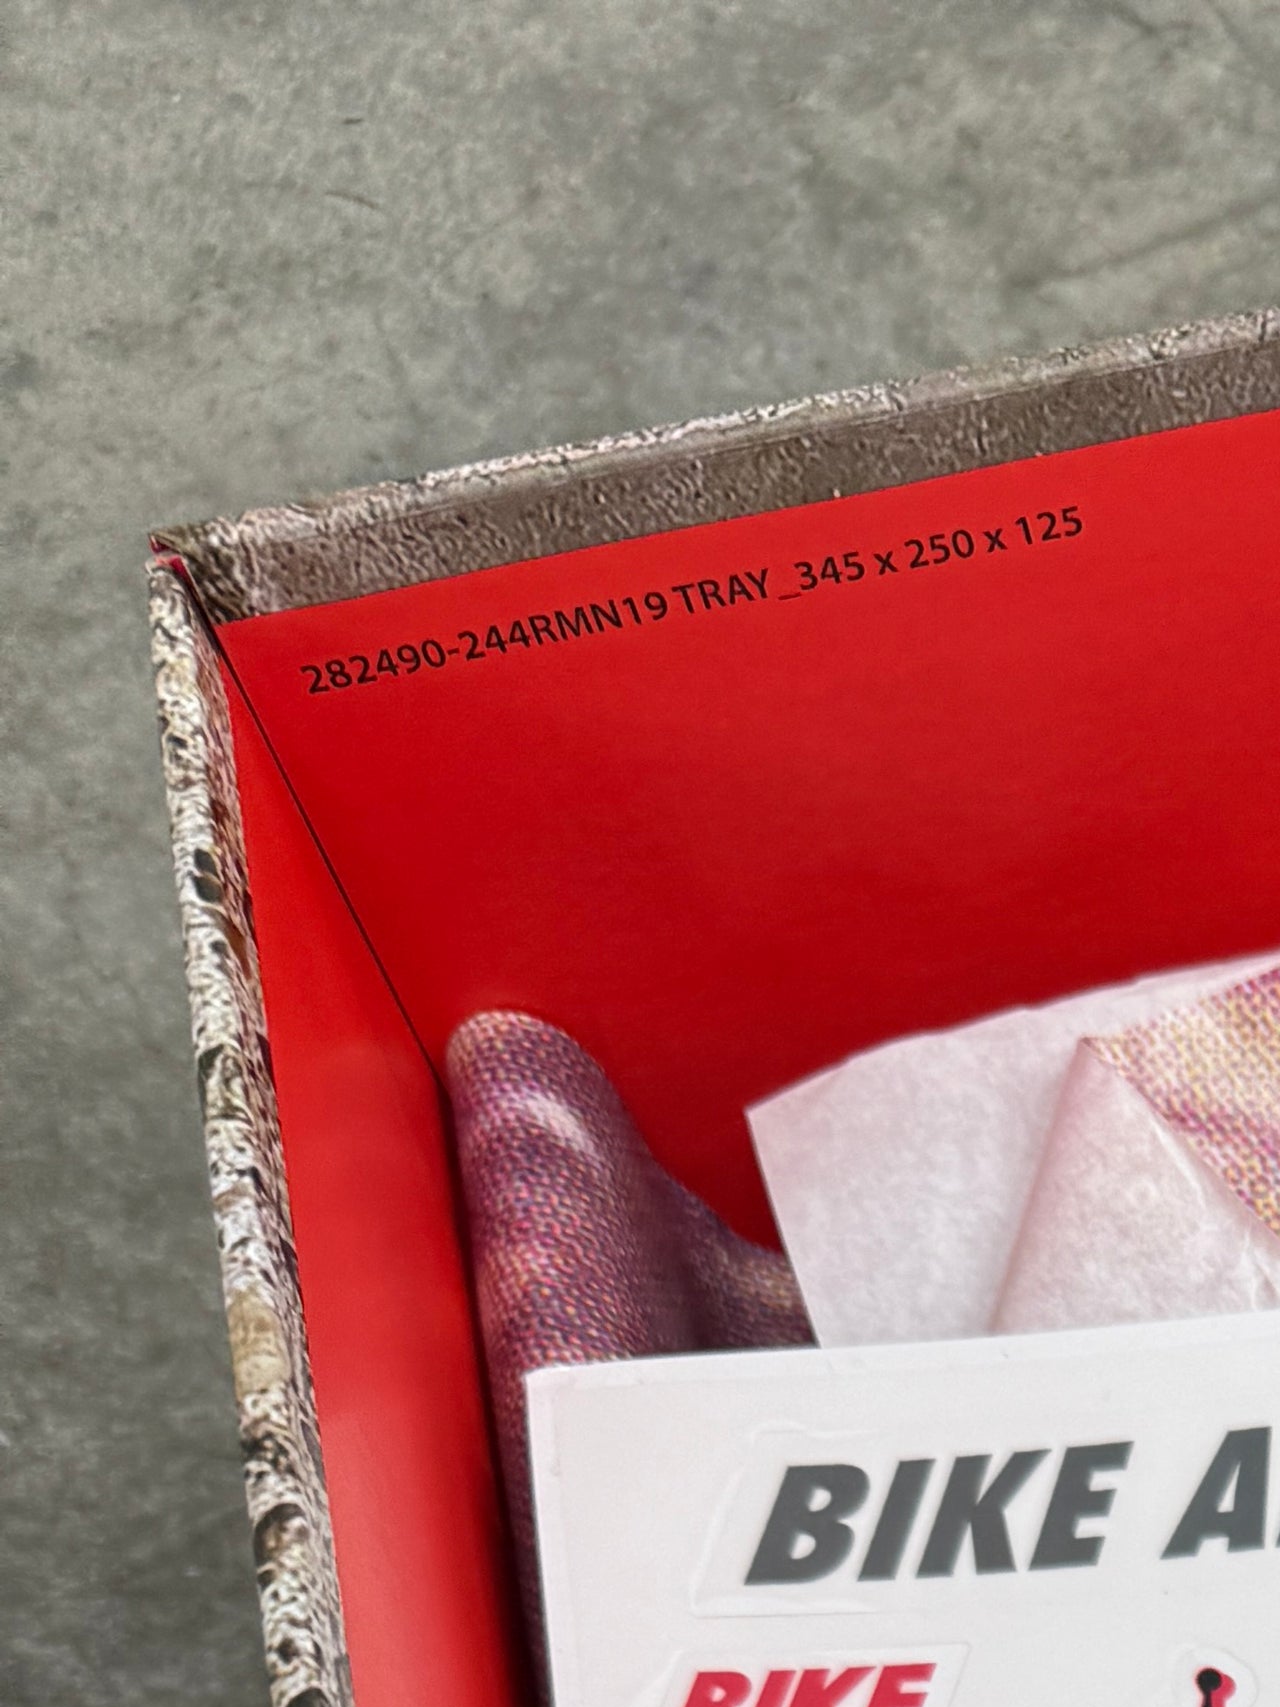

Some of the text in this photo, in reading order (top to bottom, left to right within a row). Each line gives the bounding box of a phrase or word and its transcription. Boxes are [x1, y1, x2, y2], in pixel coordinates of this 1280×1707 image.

[299, 593, 668, 696] 282490-244RMN19
[905, 528, 975, 570] 250
[1014, 505, 1085, 547] 125
[744, 1440, 1135, 1586] BIKE
